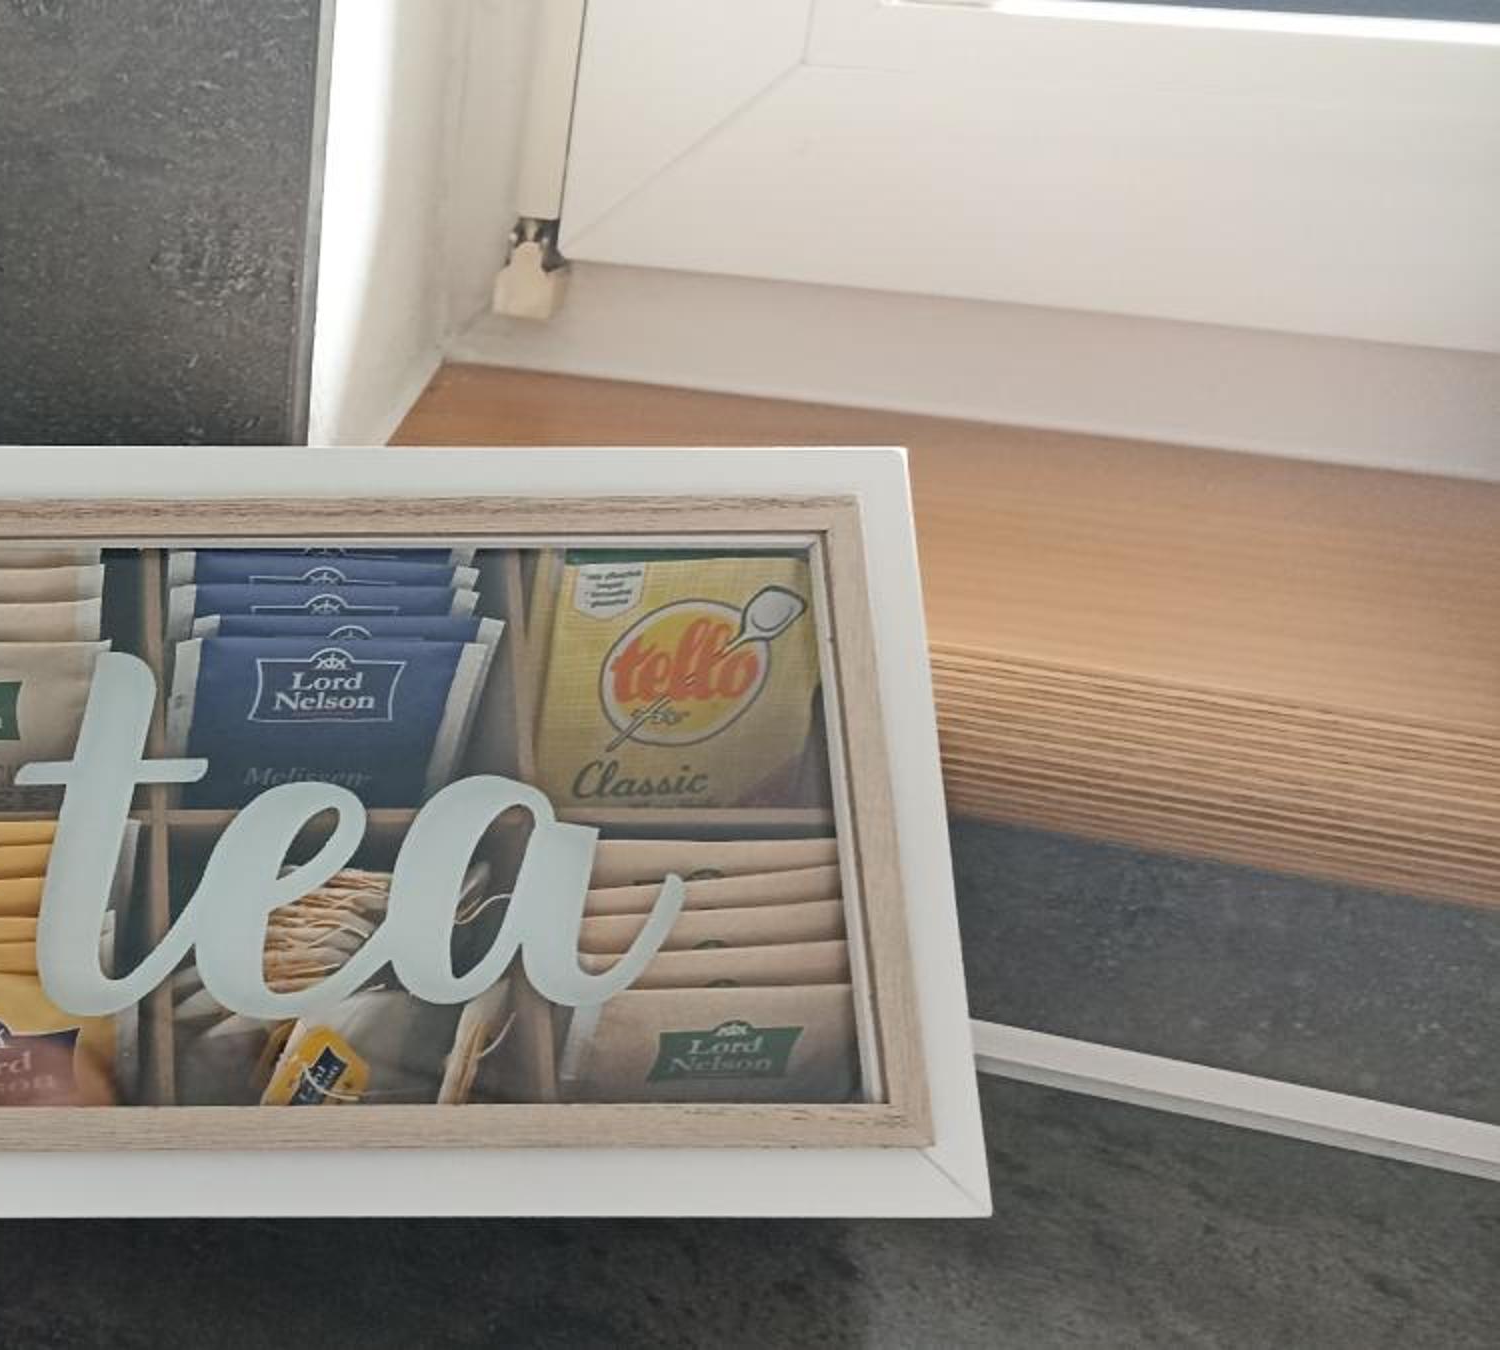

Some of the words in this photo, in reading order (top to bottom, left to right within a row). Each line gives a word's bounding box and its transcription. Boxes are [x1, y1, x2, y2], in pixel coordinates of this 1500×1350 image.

[611, 617, 758, 703] tello
[292, 671, 363, 691] Lord
[273, 690, 376, 711] Nelson
[572, 759, 709, 800] Classic
[13, 651, 686, 1018] tea
[687, 1036, 765, 1056] Lord
[668, 1055, 773, 1074] Nelson
